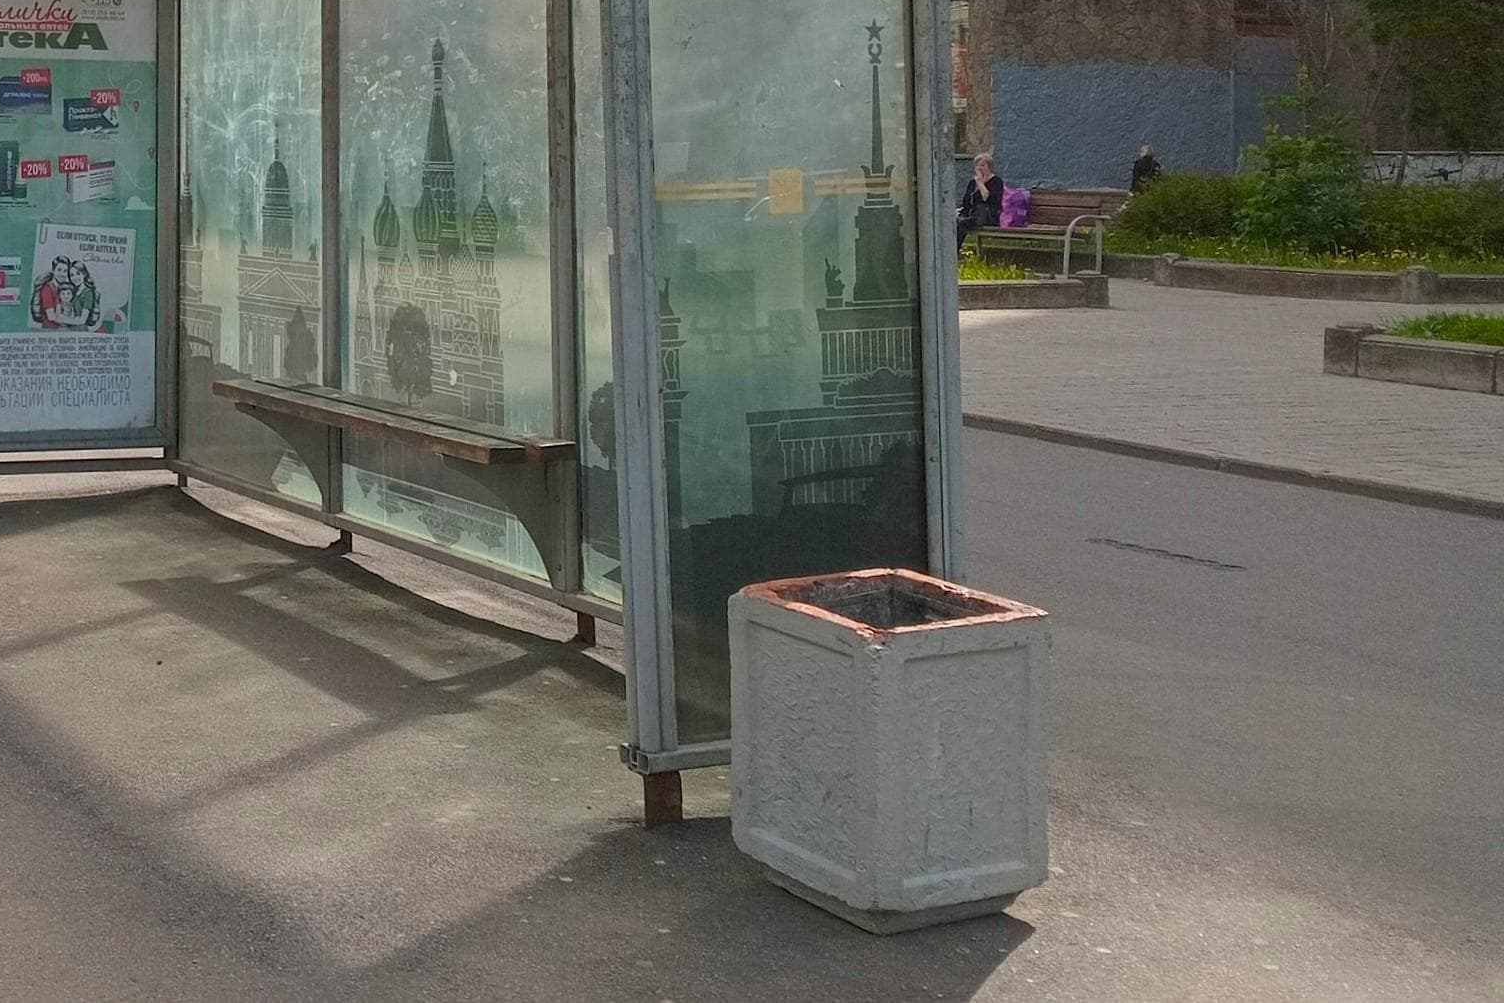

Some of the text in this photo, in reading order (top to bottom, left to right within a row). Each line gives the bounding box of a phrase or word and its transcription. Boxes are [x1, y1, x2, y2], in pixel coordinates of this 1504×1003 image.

[92, 92, 117, 104] -20%
[23, 163, 48, 176] -20%
[60, 158, 85, 171] -20%
[57, 375, 131, 391] НЕОБХОДИМО
[51, 390, 131, 407] СПЕЦИАЛИСТА
